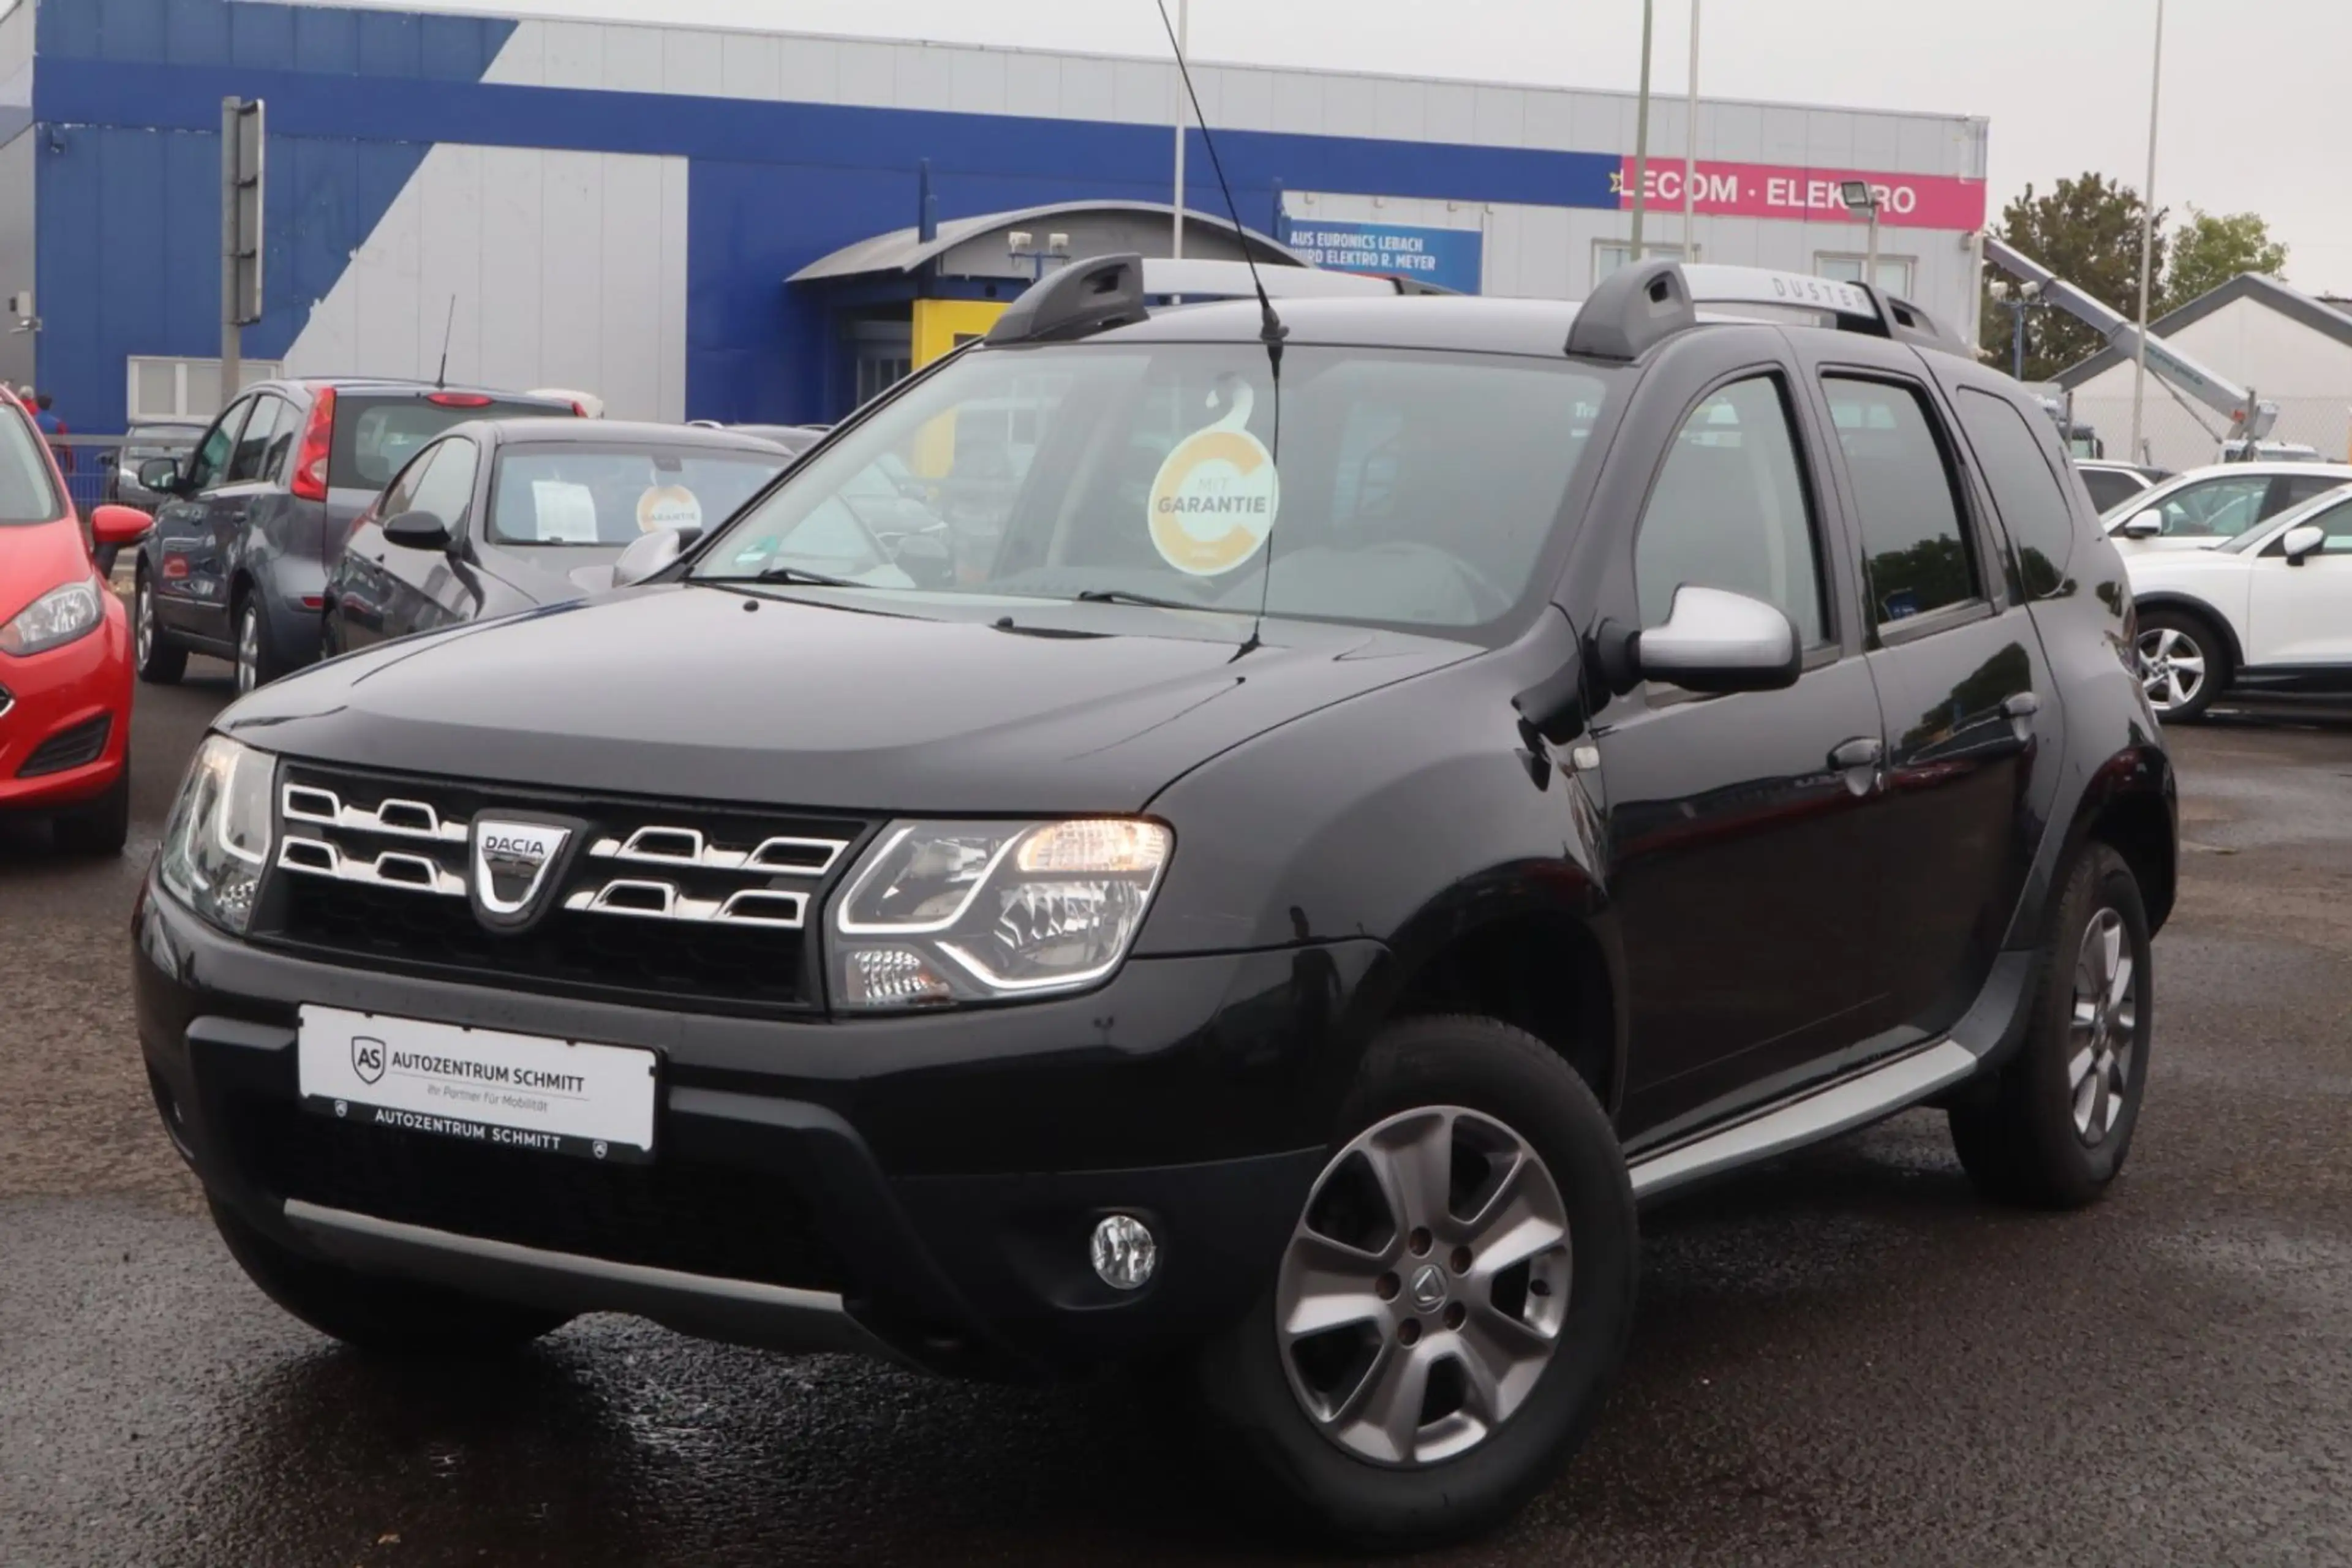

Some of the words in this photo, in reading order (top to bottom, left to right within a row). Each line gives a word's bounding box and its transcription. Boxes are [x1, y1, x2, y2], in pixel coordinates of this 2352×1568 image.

[1766, 177, 1916, 213] ELEKRO
[1290, 230, 1314, 246] AUS
[1317, 232, 1376, 249] EURONICS
[1379, 236, 1423, 252] LEBACH
[1326, 249, 1378, 266] ELEKTRO
[1381, 253, 1393, 268] R.
[1396, 254, 1436, 270] MEYER
[1772, 277, 1868, 310] DUSTER
[1157, 496, 1266, 513] GARANTIE
[486, 836, 544, 854] DACIA
[358, 1047, 381, 1070] AS
[391, 1052, 509, 1083] AUTOZENTRUM
[513, 1068, 585, 1093] SCHMITT
[375, 1108, 486, 1140] AUTOZENTRUM
[492, 1127, 560, 1150] SCHMITT
